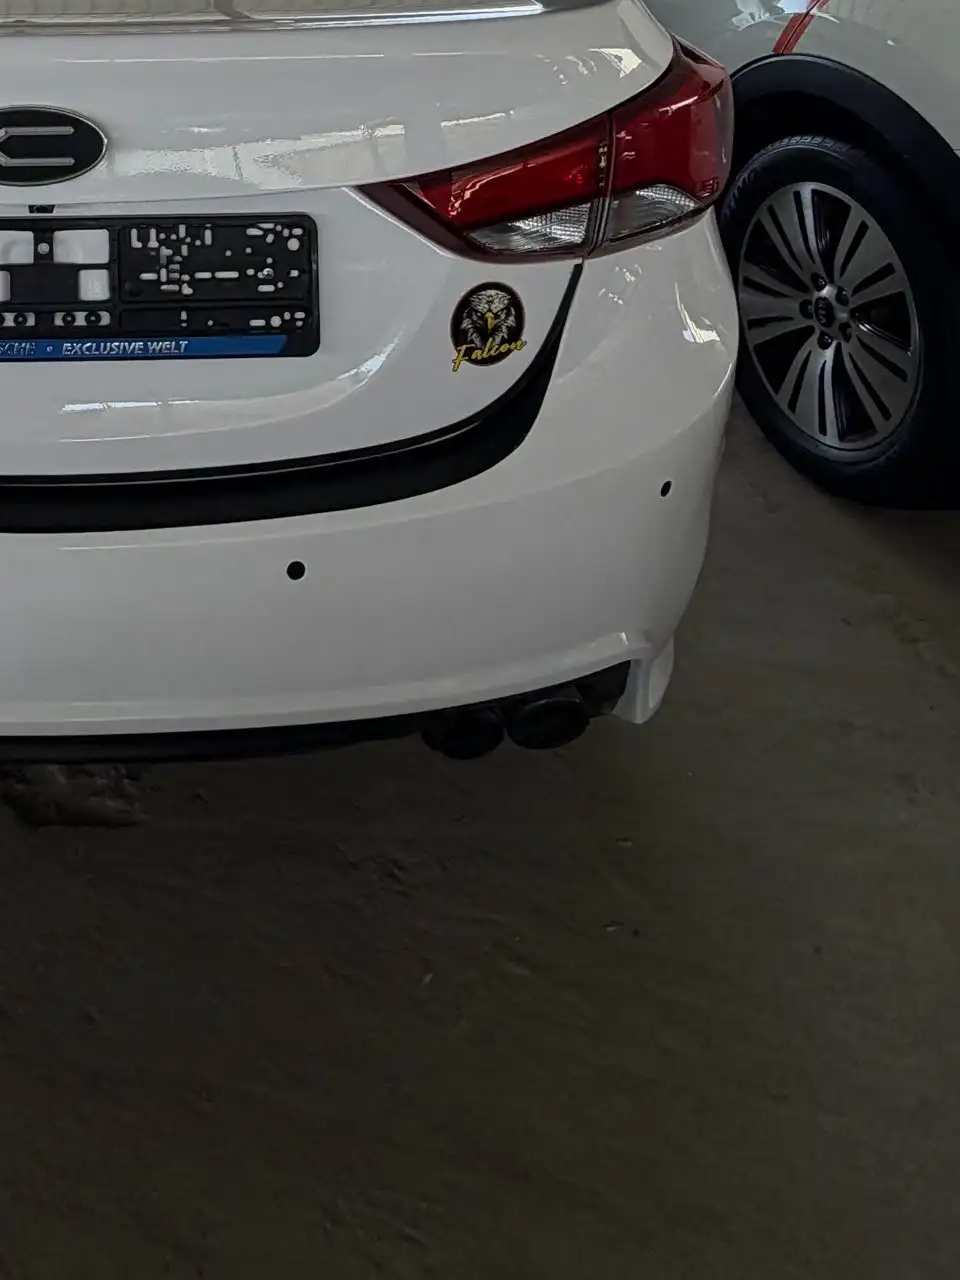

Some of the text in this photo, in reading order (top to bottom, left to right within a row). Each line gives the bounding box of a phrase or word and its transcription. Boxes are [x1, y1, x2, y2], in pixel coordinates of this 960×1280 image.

[62, 342, 144, 355] EXCLUSIVE
[147, 340, 189, 354] WELT
[452, 338, 527, 372] Falcon
